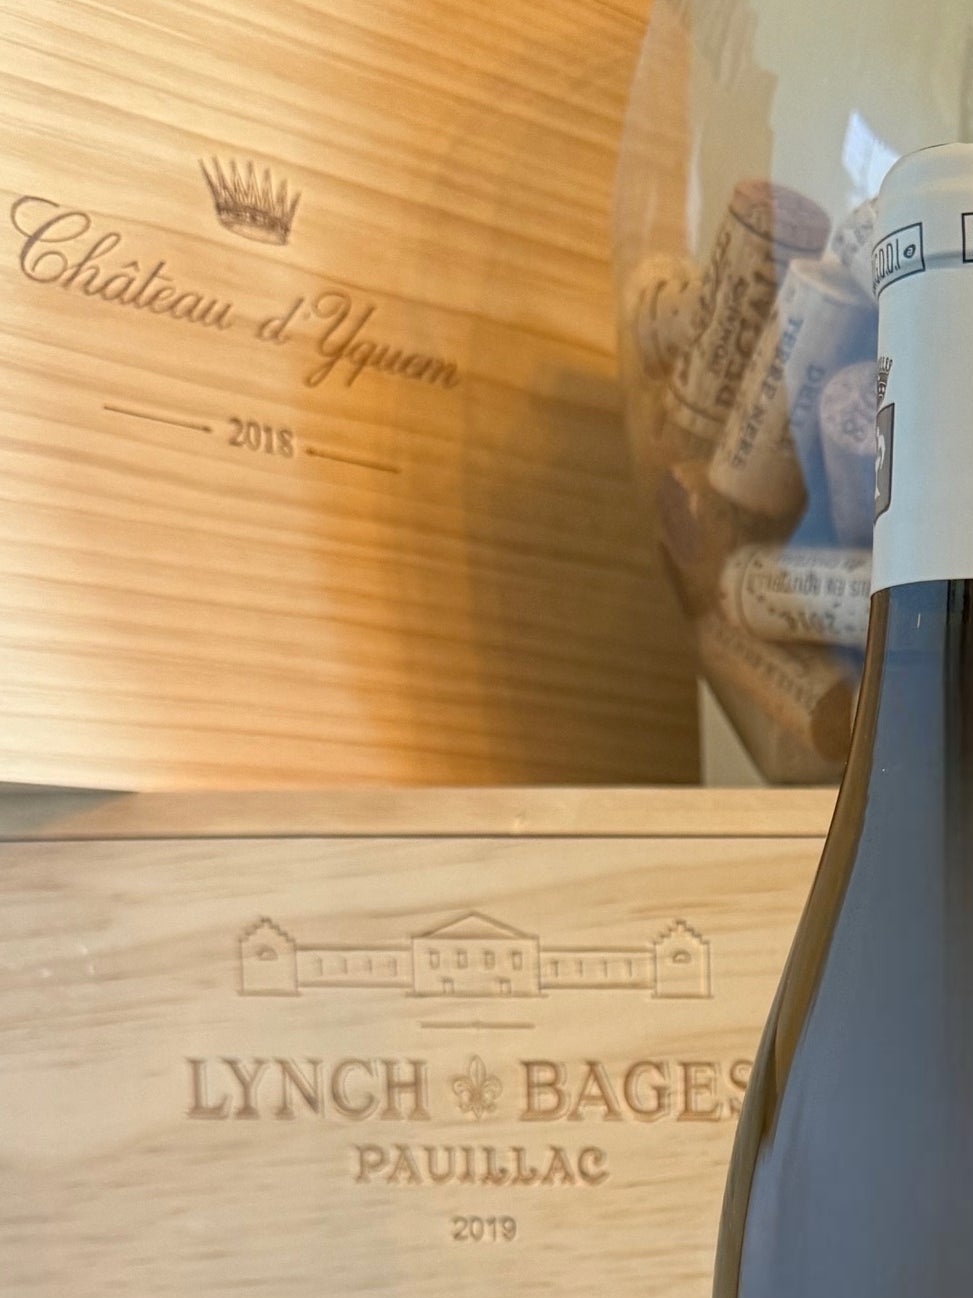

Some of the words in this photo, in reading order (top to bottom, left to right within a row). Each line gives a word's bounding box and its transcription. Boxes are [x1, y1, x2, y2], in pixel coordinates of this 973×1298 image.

[10, 196, 233, 331] Château
[255, 287, 460, 388] d'Yquem
[228, 416, 294, 458] 2018
[185, 1056, 430, 1122] LYNCH
[518, 1058, 754, 1122] BAGES
[353, 1144, 609, 1186] PAUILLAC
[451, 1215, 518, 1243] 2019
